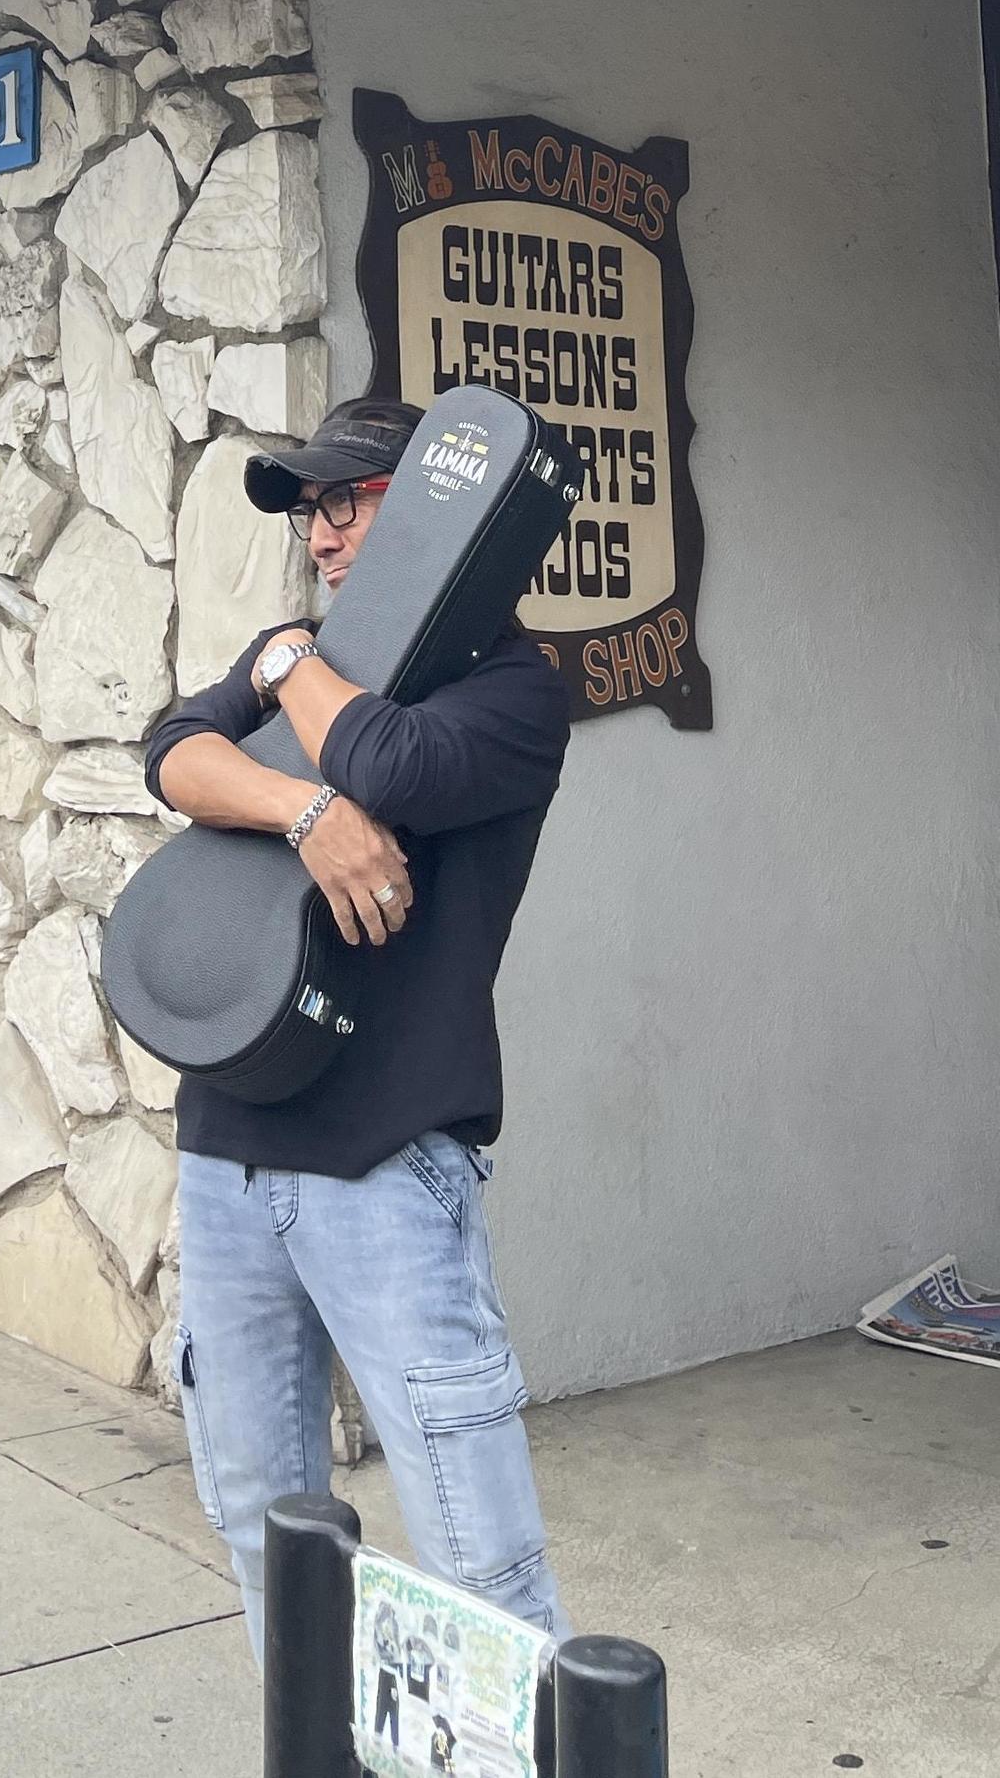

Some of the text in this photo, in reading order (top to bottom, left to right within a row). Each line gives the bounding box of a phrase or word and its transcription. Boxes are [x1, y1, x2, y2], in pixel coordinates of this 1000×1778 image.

[467, 129, 671, 242] McCABE'S
[442, 224, 623, 320] GUITARS
[430, 317, 637, 411] LESSONS
[420, 442, 489, 485] KAMAKA
[583, 608, 689, 706] SHOP
